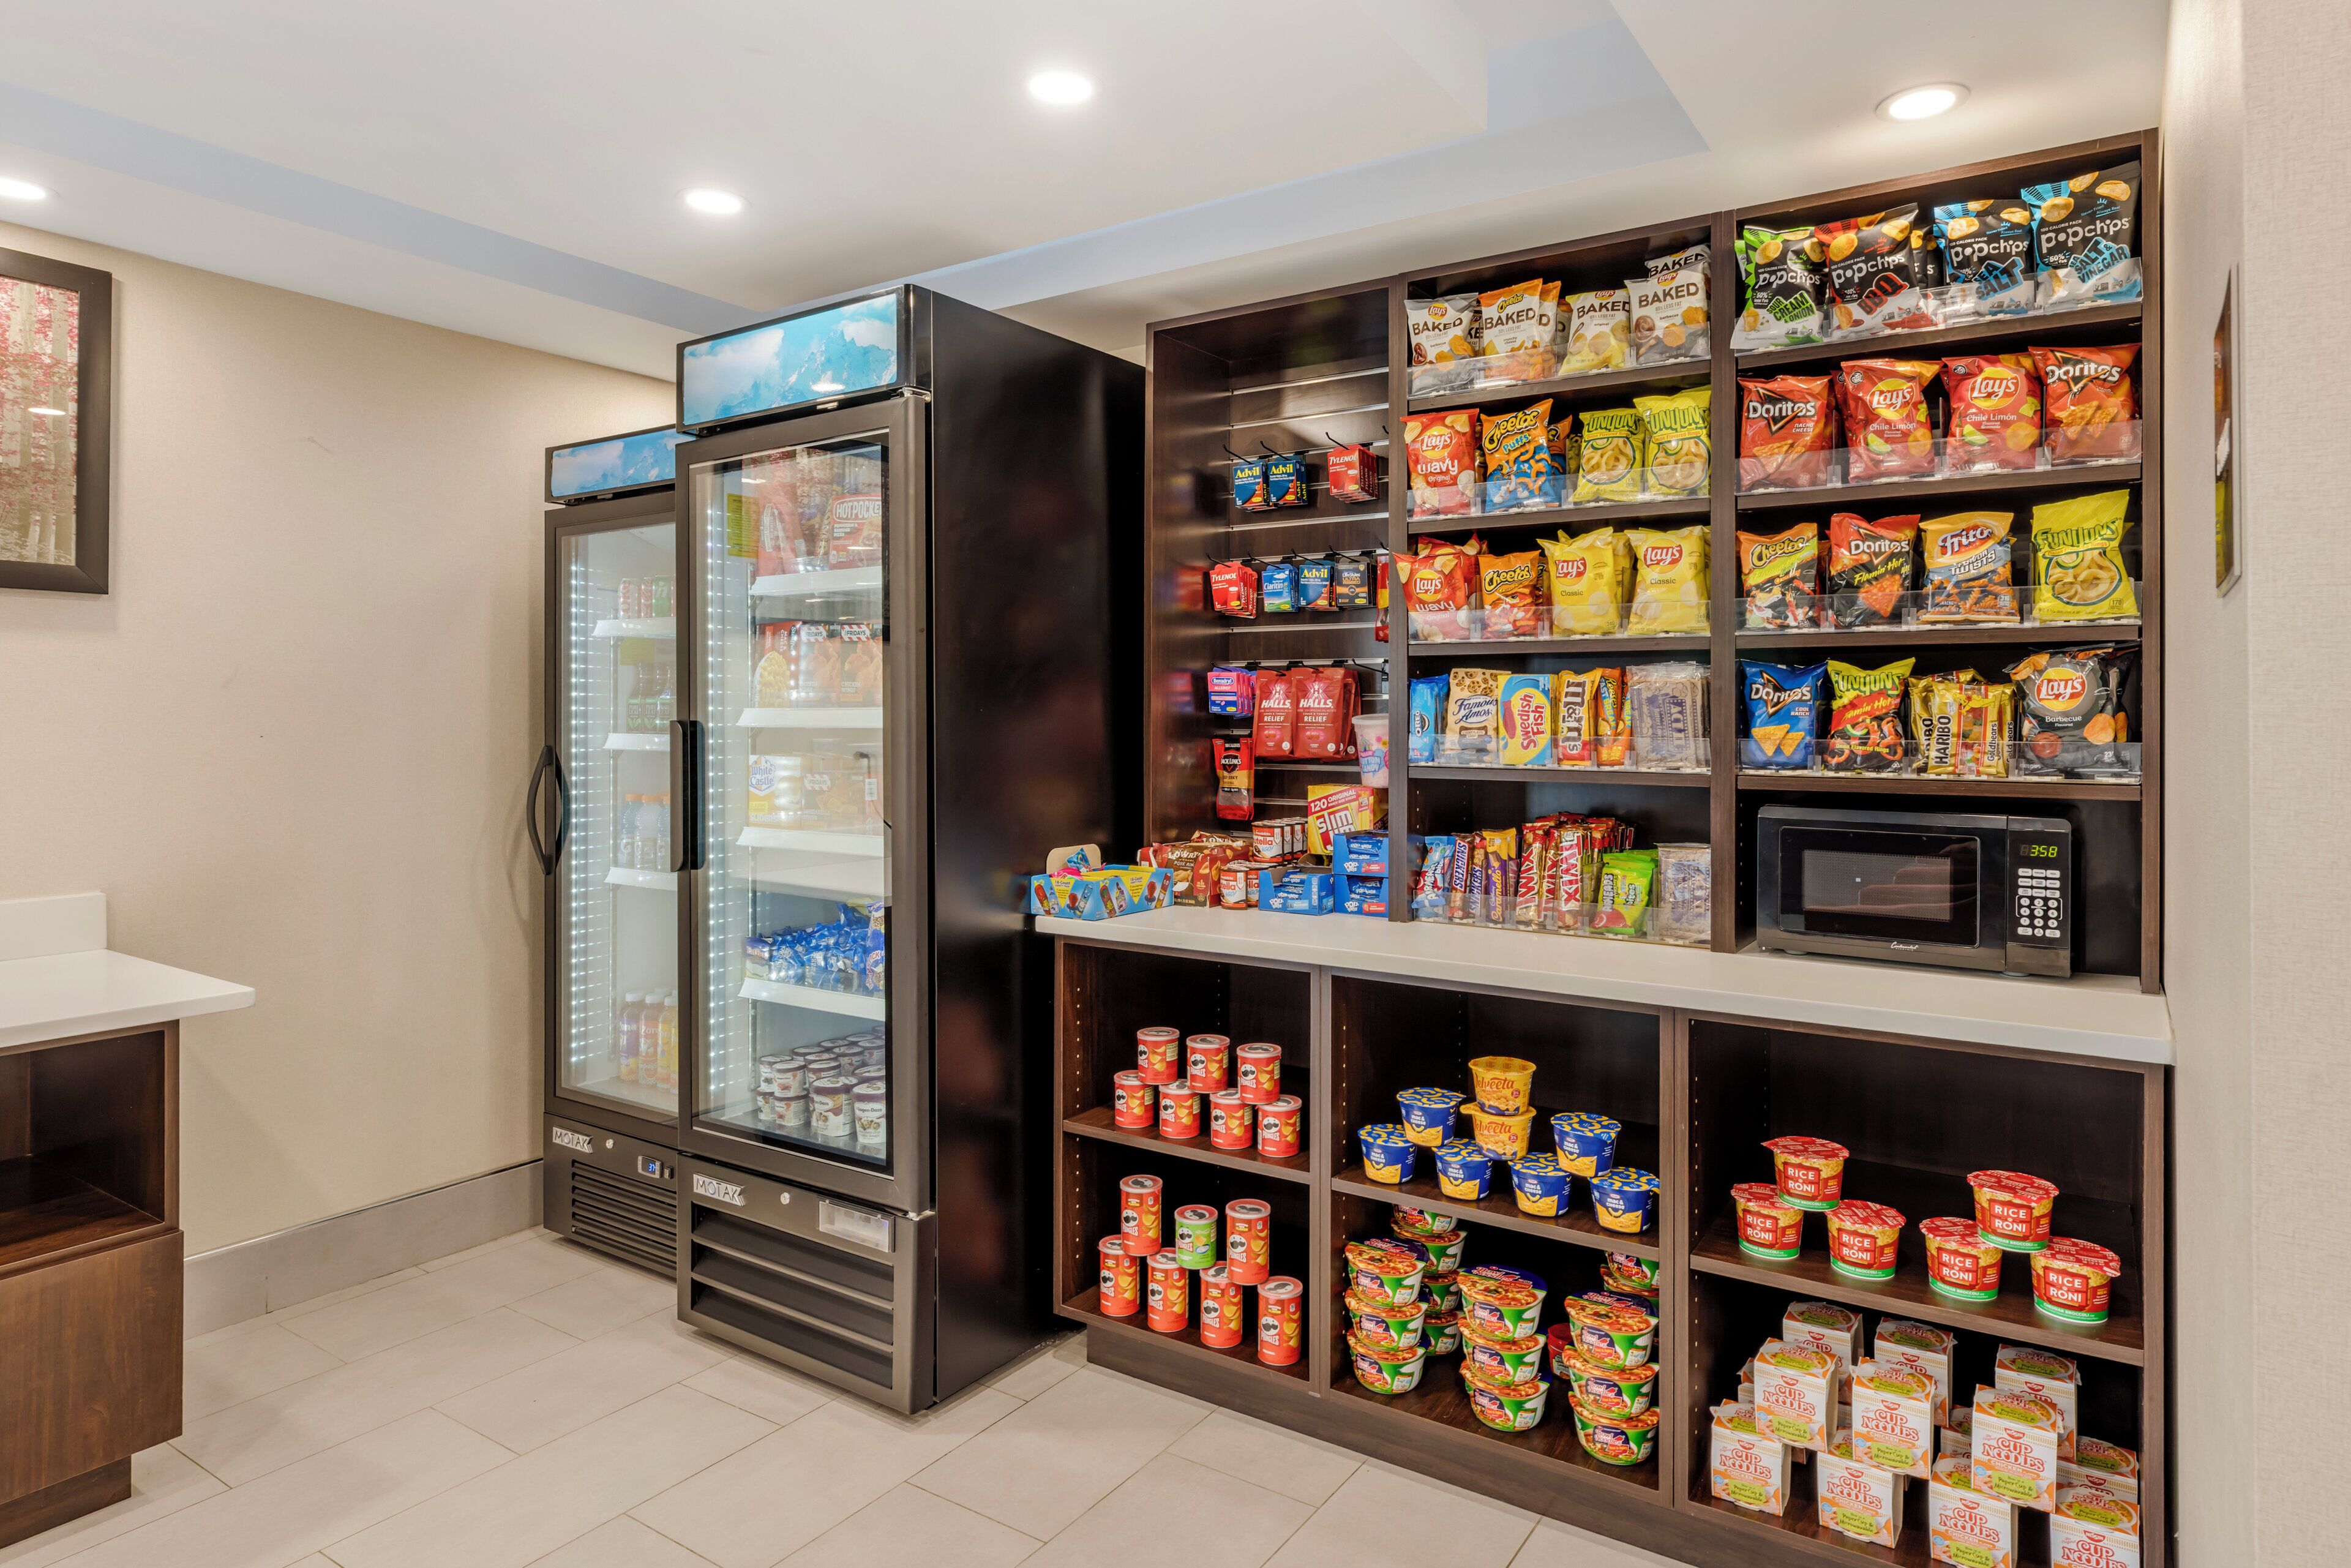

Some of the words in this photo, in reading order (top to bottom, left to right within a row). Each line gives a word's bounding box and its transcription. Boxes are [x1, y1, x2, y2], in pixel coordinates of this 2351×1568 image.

[2041, 217, 2130, 253] popchips
[1950, 240, 2028, 263] popchips
[2075, 241, 2103, 275] SALT
[1831, 253, 1905, 288] popchips
[2078, 248, 2128, 283] VINEGAR
[1659, 272, 1678, 282] Lay's
[1755, 271, 1820, 288] popchips
[1976, 263, 2019, 299] SALT
[1498, 293, 1524, 313] Cheetos
[1638, 282, 1700, 309] BAKED
[1767, 297, 1787, 313] SOUR
[1428, 306, 1446, 316] Lay's
[1577, 301, 1630, 319] BAKED
[1774, 291, 1810, 321] CREAM
[1788, 306, 1816, 321] ONION
[1412, 317, 1463, 336] BAKED
[1484, 307, 1535, 330] BAKED
[2046, 362, 2121, 384] Doritos
[1972, 377, 2017, 399] Lay's
[1872, 388, 1912, 411] Lay's
[1749, 402, 1816, 418] Doritos
[1643, 406, 1709, 434] FUNYUNS
[1891, 422, 1916, 430] Limón
[1422, 432, 1451, 451] Lay's
[1502, 433, 1530, 454] Puffs
[1270, 464, 1293, 475] Advil
[1329, 455, 1357, 465] TYLENOL
[1417, 459, 1458, 475] wavy
[1235, 467, 1260, 478] Advil
[836, 502, 852, 518] HOT
[1937, 527, 1993, 557] Fritos
[2034, 517, 2119, 549] FUNYUNS
[1646, 546, 1681, 565] Lay's
[1751, 537, 1806, 568] Cheetos
[1850, 539, 1910, 554] Doritos
[1949, 550, 1996, 576] TWISTS
[1212, 573, 1237, 582] TYLENOL
[1301, 568, 1328, 579] Advil
[1485, 565, 1531, 593] Cheetos
[1415, 578, 1441, 595] Lay's
[1415, 600, 1457, 612] wavy
[1750, 683, 1812, 702] Doritos
[1830, 670, 1904, 698] FUNYUNS
[2039, 677, 2083, 701] Lay's
[1261, 699, 1291, 708] HALLS
[1299, 699, 1332, 708] HALLS
[1453, 697, 1498, 715] Famous
[1455, 709, 1491, 724] Amos
[1520, 692, 1534, 751] Swedish
[1531, 703, 1545, 735] Fish
[1561, 679, 1588, 753] m&m's
[1934, 715, 1952, 765] HARIBO
[1987, 722, 1998, 762] Goldbears
[751, 766, 772, 776] White
[750, 776, 774, 786] Castle
[1310, 800, 1327, 812] 120
[1328, 789, 1356, 801] ORIGINAL
[1317, 809, 1353, 833] slim
[2030, 845, 2057, 857] 3:58
[1453, 840, 1468, 891] SNICKERS
[1560, 833, 1582, 910] TWIX
[1517, 847, 1539, 910] TWIX
[1469, 866, 1482, 913] SNICKERS
[1491, 869, 1502, 921] Caramello
[1190, 1067, 1205, 1078] PRINGLES
[1240, 1078, 1256, 1088] PRINGLES
[555, 1130, 588, 1150] MOTAK
[1262, 1133, 1280, 1141] PRINGLES
[1788, 1168, 1815, 1180] RICE
[696, 1176, 741, 1204] MOTAK
[1788, 1180, 1814, 1193] RONI
[1995, 1205, 2027, 1218] RICE
[1747, 1215, 1772, 1228] RICE
[1995, 1219, 2026, 1232] RONI
[1747, 1228, 1772, 1240] RONI
[1842, 1234, 1870, 1247] RICE
[1229, 1253, 1247, 1263] PRINGLES
[1842, 1247, 1870, 1261] RONI
[1261, 1335, 1279, 1345] PRINGLES
[1775, 1384, 1805, 1401] CUP
[1763, 1390, 1816, 1416] NOODLES
[1875, 1409, 1908, 1425] CUP
[1862, 1416, 1919, 1441] NOODLES
[1997, 1437, 2033, 1455] CUP
[1731, 1448, 1761, 1465] CUP
[1982, 1443, 2044, 1472] NOODLES
[1720, 1455, 1771, 1479] NOODLES
